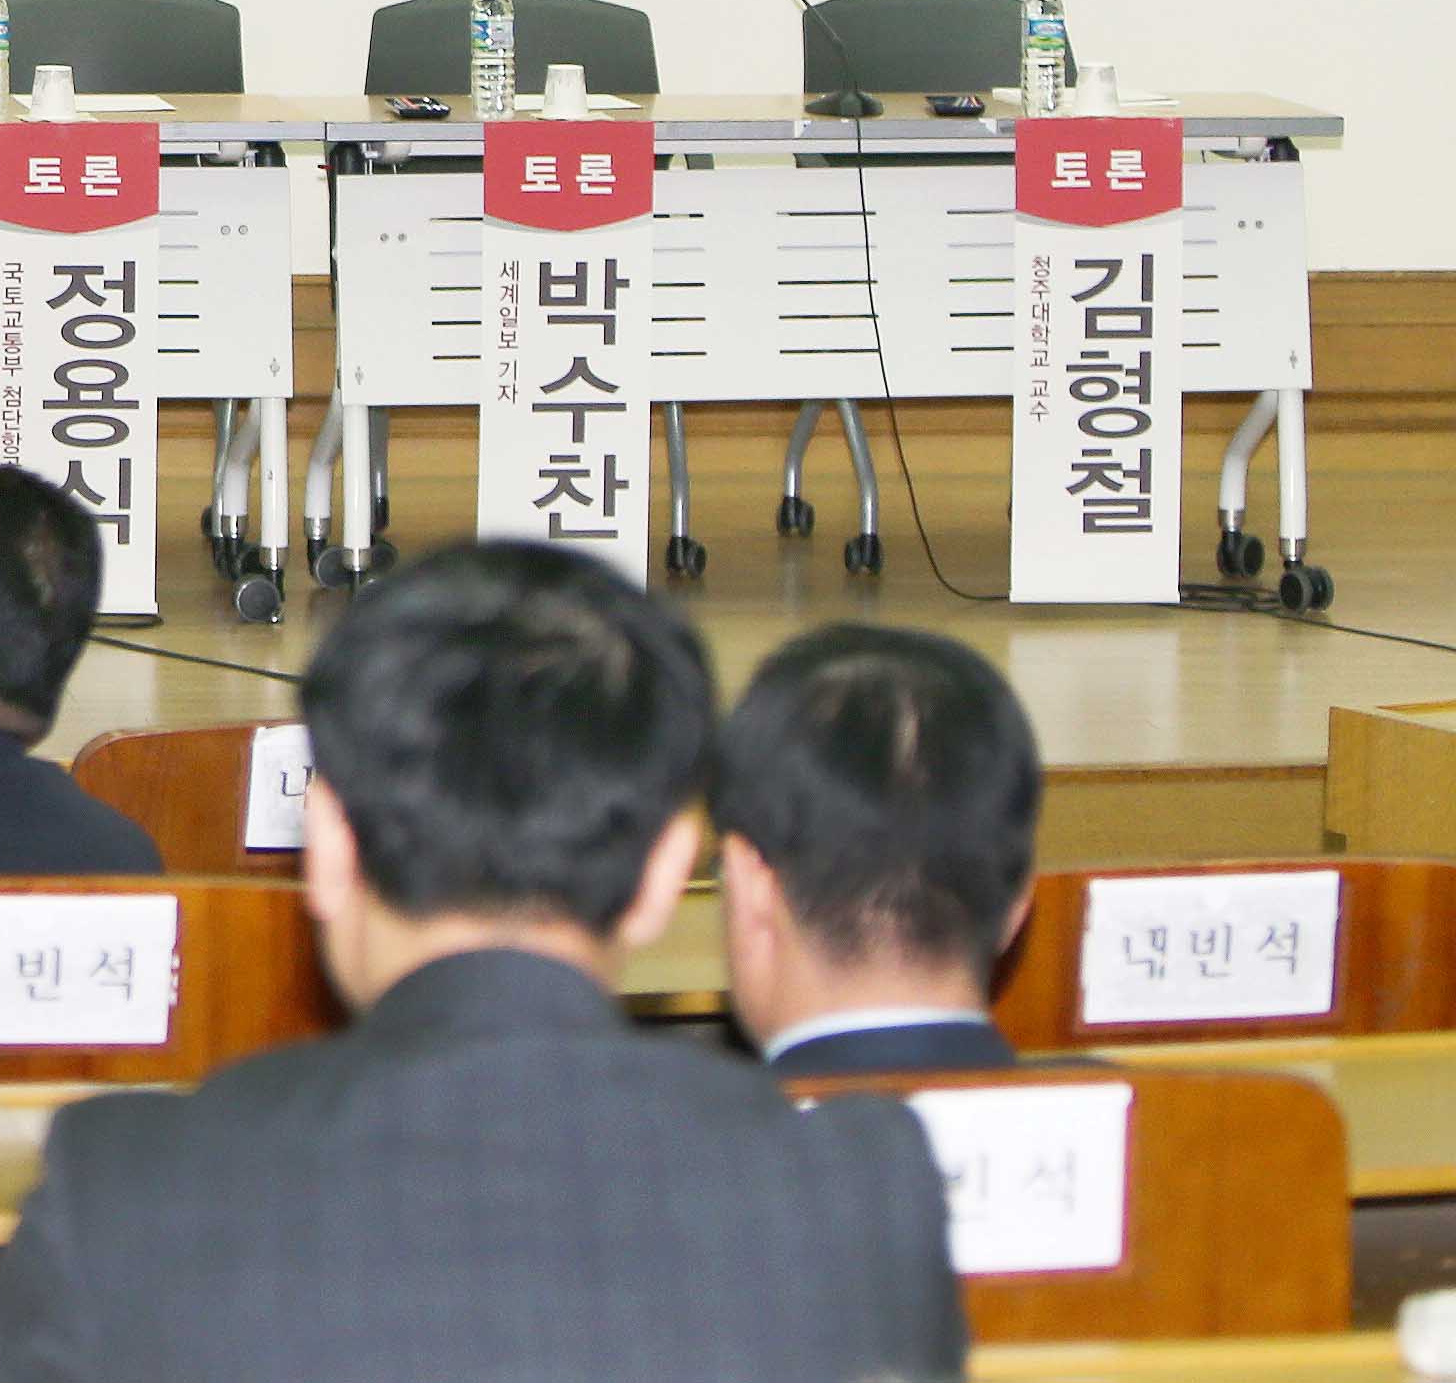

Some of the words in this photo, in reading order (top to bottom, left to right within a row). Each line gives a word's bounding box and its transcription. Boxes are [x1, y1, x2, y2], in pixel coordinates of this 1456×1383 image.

[2, 262, 25, 378] 국토교통부
[498, 260, 520, 349] 세계일보
[1, 384, 24, 467] 첨단항
[42, 260, 140, 545] 정용식
[497, 360, 518, 404] 기자
[531, 258, 630, 540] 박수찬
[1030, 380, 1048, 422] 교수
[1065, 253, 1154, 534] 김형철
